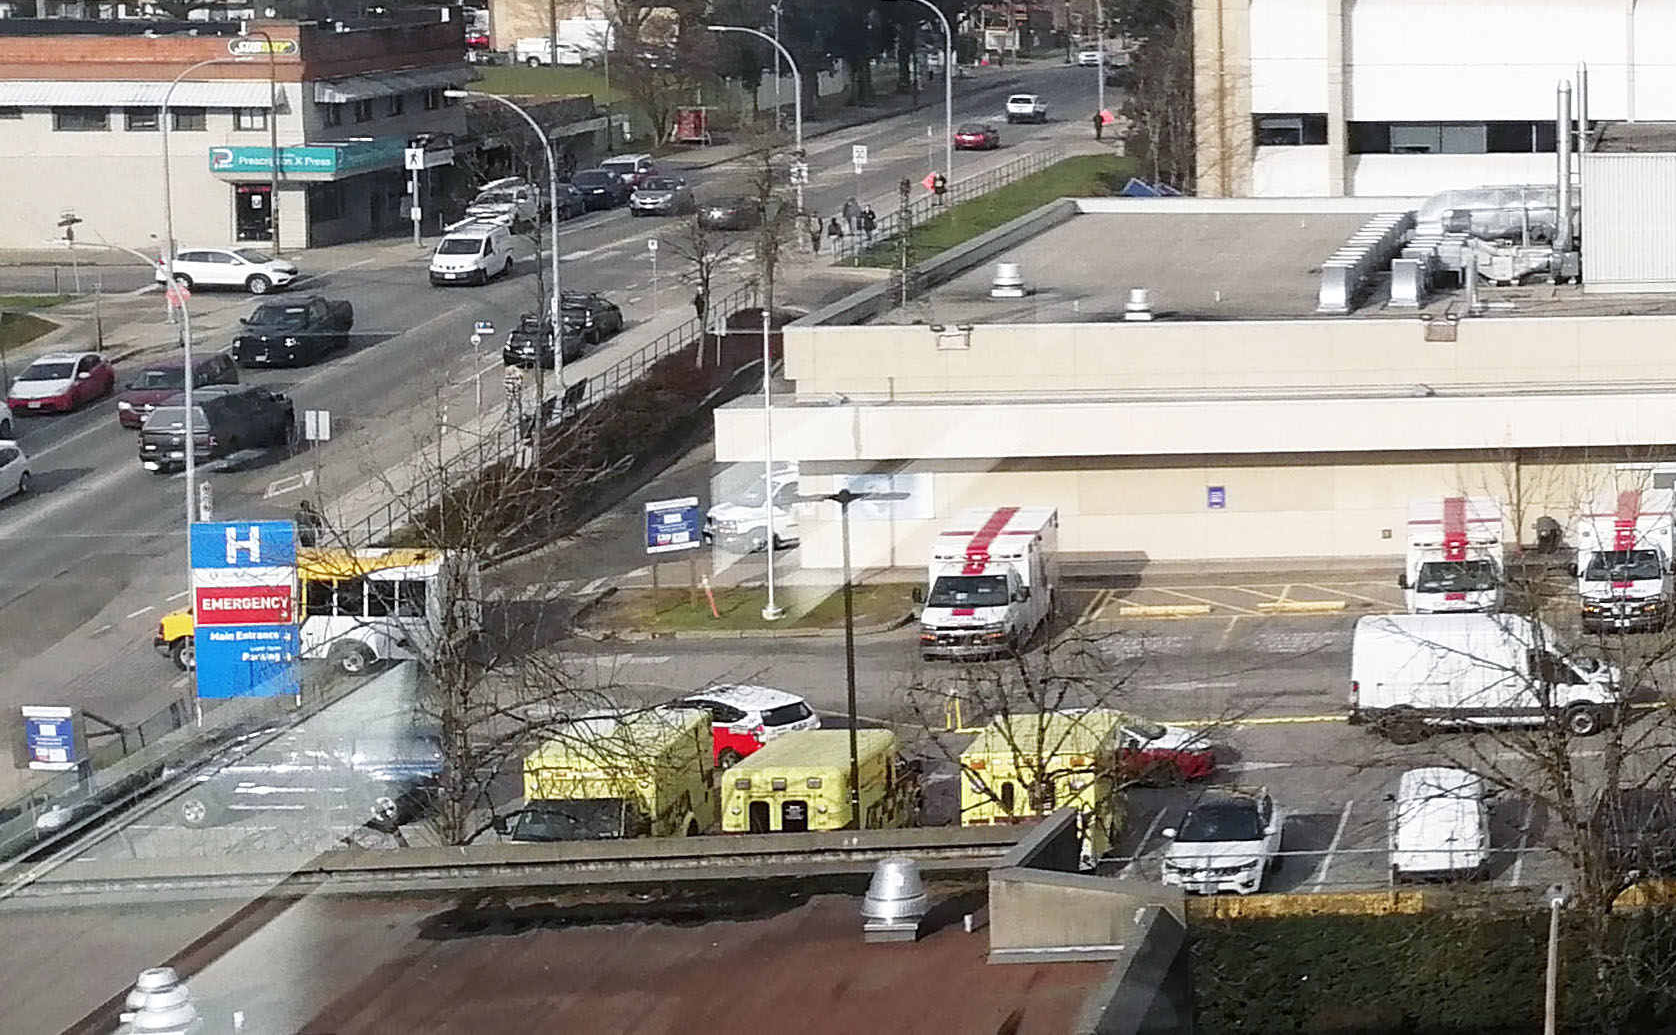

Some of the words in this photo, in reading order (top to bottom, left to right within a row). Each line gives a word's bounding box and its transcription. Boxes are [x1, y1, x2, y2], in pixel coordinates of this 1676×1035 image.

[239, 156, 292, 168] Prescripion
[305, 156, 331, 166] Press
[226, 525, 261, 564] H
[202, 596, 288, 611] EMERGENCY
[209, 631, 234, 642] Main
[235, 631, 279, 641] Entrance
